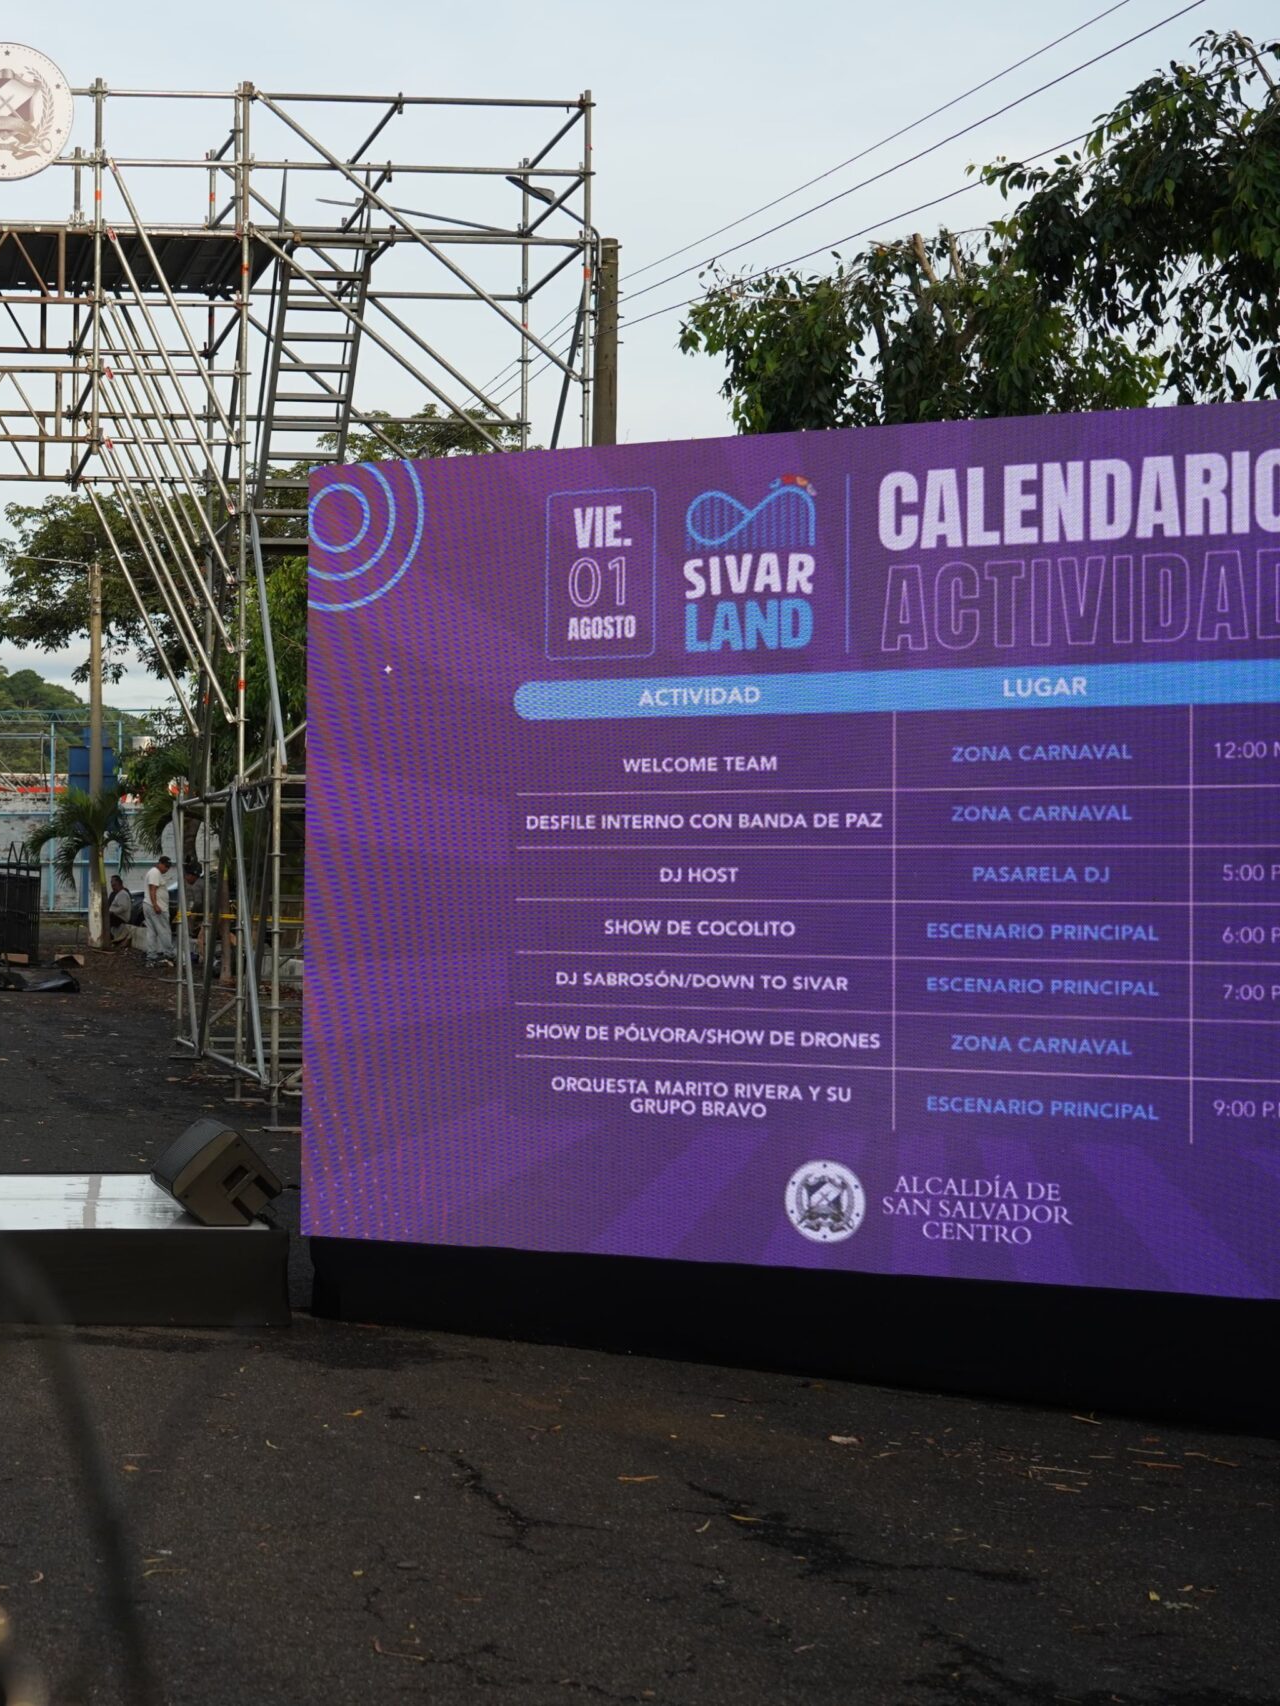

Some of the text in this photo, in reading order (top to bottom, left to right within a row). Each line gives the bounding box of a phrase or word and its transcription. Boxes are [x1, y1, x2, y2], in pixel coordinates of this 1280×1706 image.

[574, 506, 631, 548] VIE.
[567, 555, 626, 608] 01
[684, 553, 814, 601] SIVAR
[568, 615, 635, 641] AGOSTO
[685, 599, 813, 653] LAND
[639, 687, 760, 706] ACTIVIDAD
[1004, 677, 1086, 697] LUGAR
[952, 744, 1132, 762] ZONA CARNAVAL
[1215, 742, 1267, 759] 12:00
[623, 756, 777, 772] WELCOME TEAM
[527, 813, 882, 830] DESFILE INTERNO CON BANDA DE PAZ
[952, 806, 1132, 822] ZONA CARNAVAL
[660, 868, 738, 883] DJ HOST
[973, 867, 1109, 884] PASARELA DJ
[1223, 864, 1264, 881] 5:00
[605, 920, 795, 936] SHOW DE COCOLITO
[927, 923, 1158, 941] ESCENARIO PRINCIPAL
[1223, 927, 1265, 944] 6:00
[556, 970, 847, 990] DJ SABROSÓN/DOWN TO SIVAR
[927, 977, 1158, 996] ESCENARIO PRINCIPAL
[1224, 984, 1265, 1000] 7:00
[527, 1024, 880, 1048] SHOW DE PÓLVORA/SHOW DE DRONES
[952, 1035, 1132, 1055] ZONA CARNAVAL
[552, 1077, 851, 1102] ORQUESTA MARITO RIVERA Y SU
[630, 1098, 767, 1118] GRUPO BRAVO
[927, 1096, 1158, 1120] ESCENARIO PRINCIPAL
[1213, 1100, 1255, 1117] 9:00
[894, 1176, 1060, 1201] ALCALDÍA DE
[883, 1197, 1073, 1225] SAN SALVADOR
[923, 1221, 1032, 1244] CENTRO
